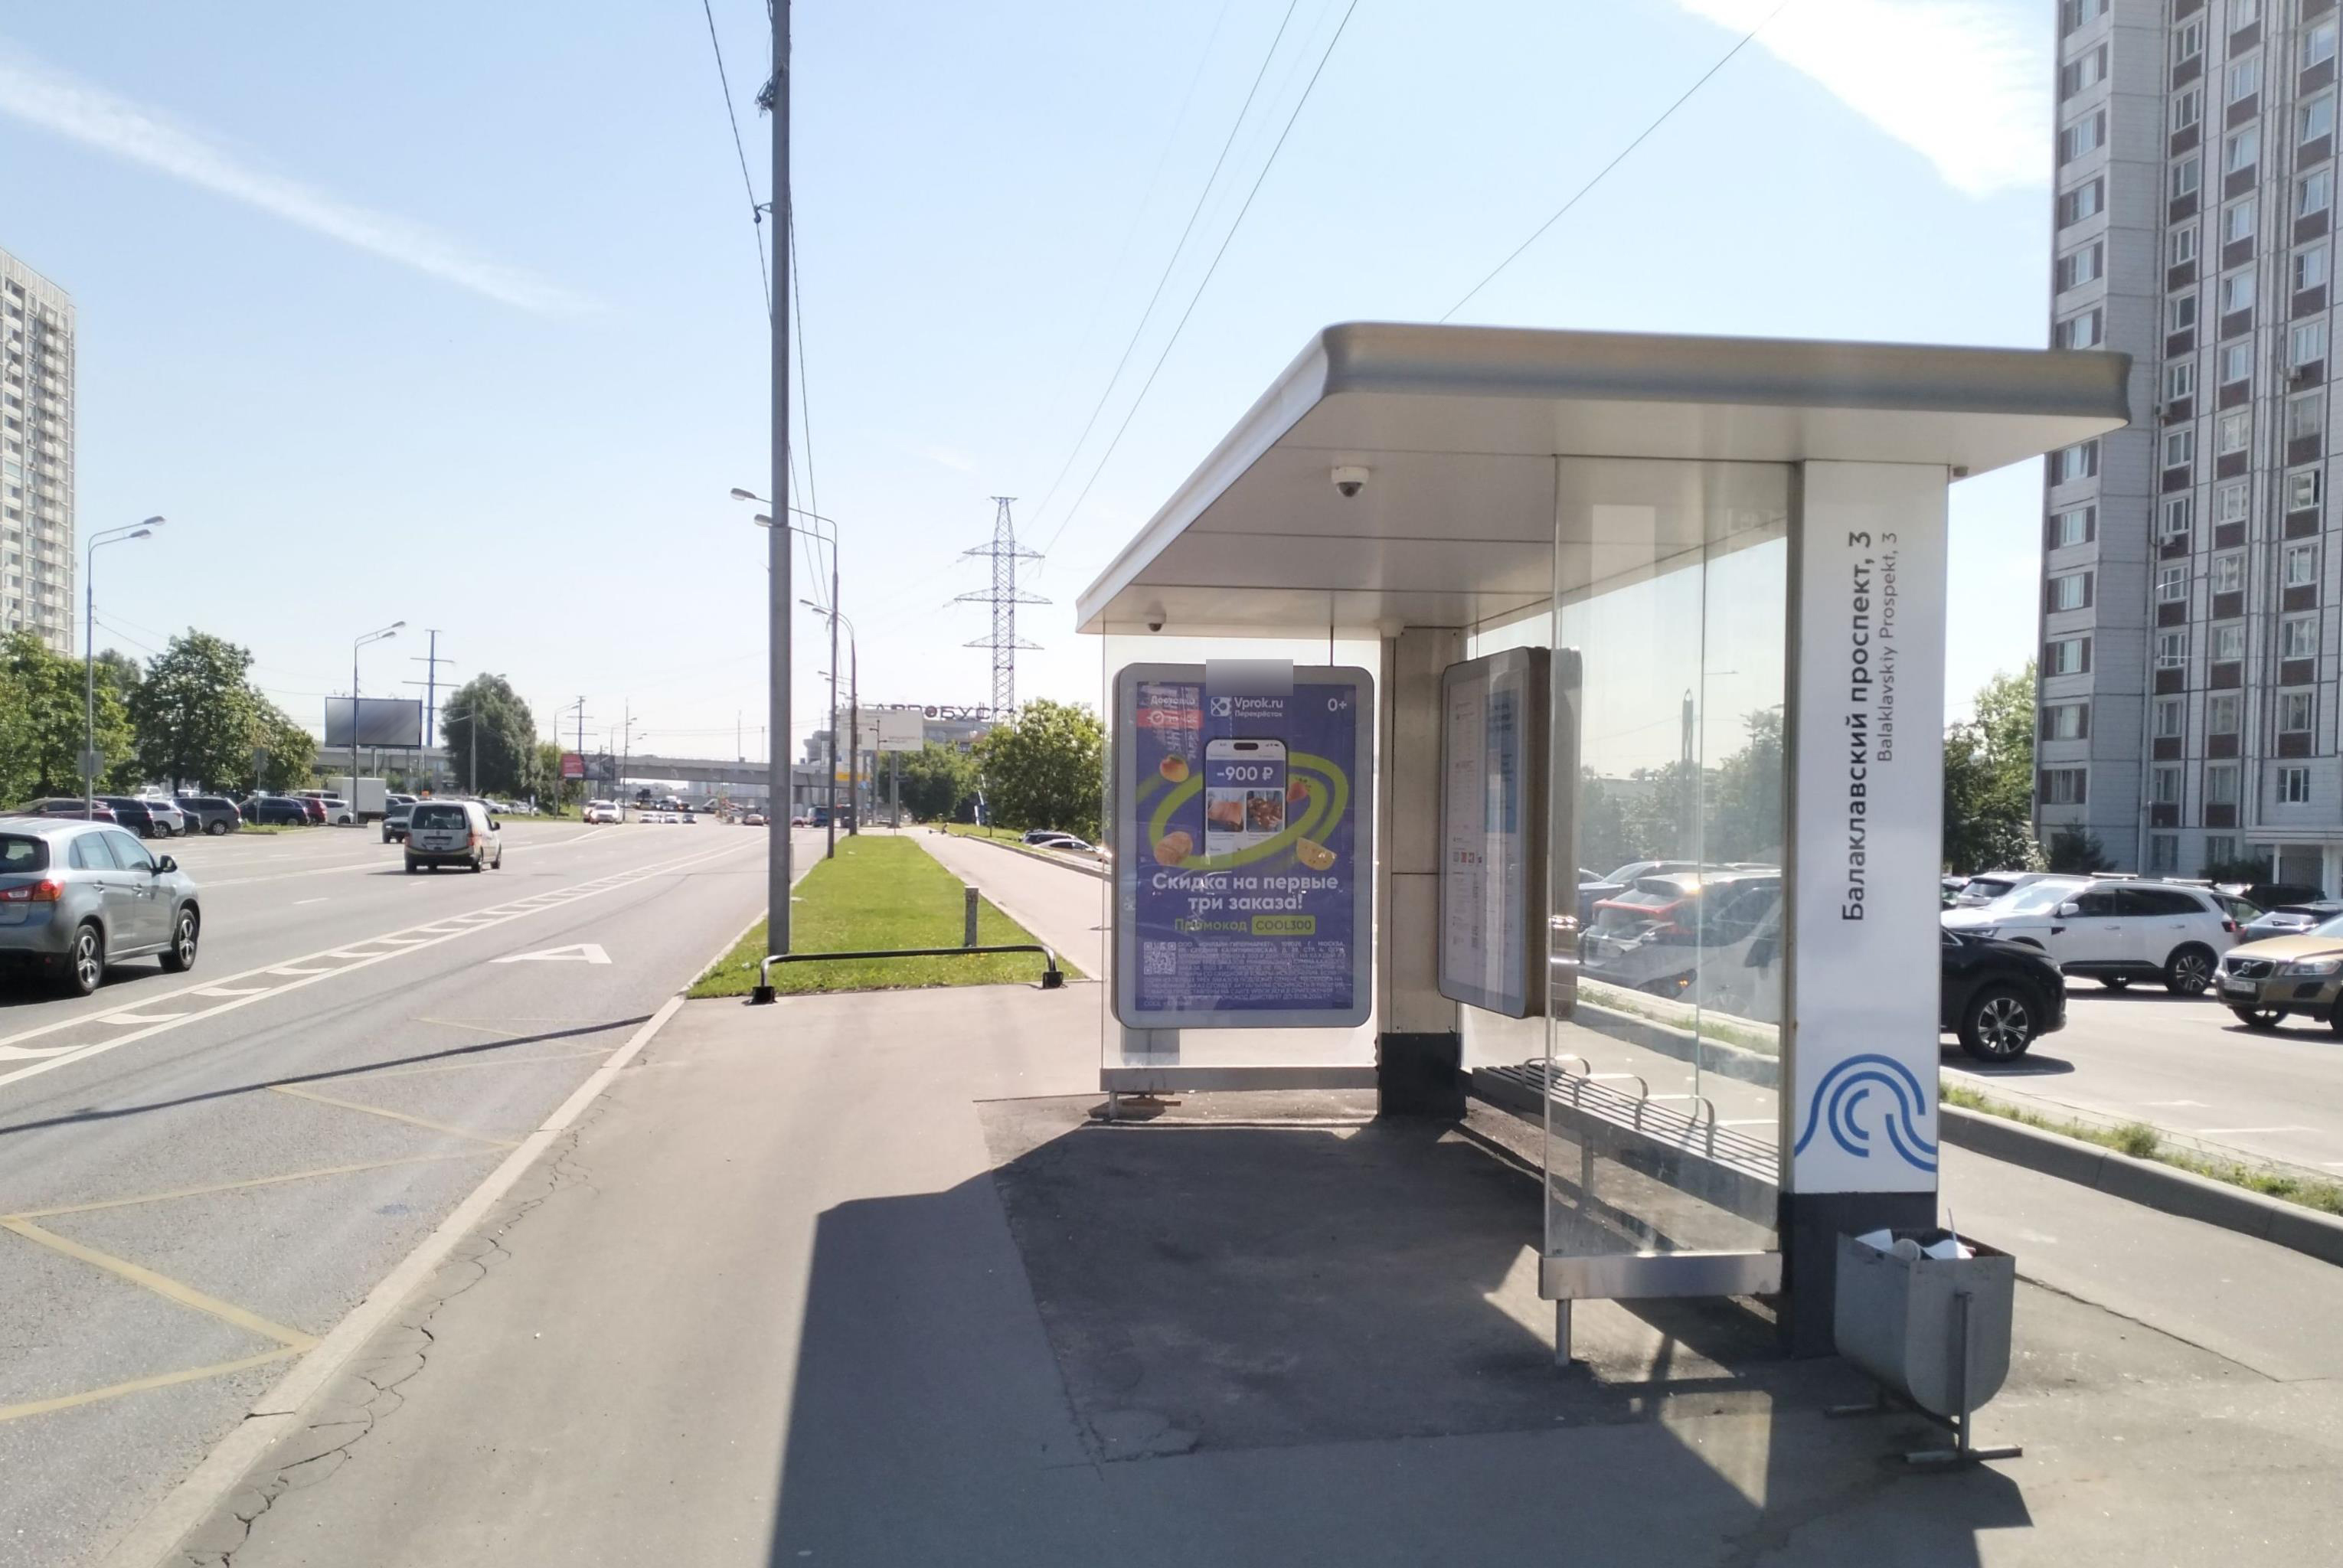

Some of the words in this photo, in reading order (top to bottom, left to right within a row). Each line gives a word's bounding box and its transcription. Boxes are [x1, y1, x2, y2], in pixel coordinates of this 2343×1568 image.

[1848, 531, 1871, 548] 3
[1881, 532, 1897, 544] 3
[1879, 550, 1898, 638] Prospekt,
[1851, 559, 1874, 702] проспект,
[1234, 697, 1283, 710] Vprok.ru
[1328, 696, 1347, 711] 0+
[1877, 646, 1898, 761] Balaklavskiy
[1842, 714, 1868, 920] Балаклавский
[1152, 874, 1227, 892] Скидка
[1233, 876, 1256, 890] на
[1263, 876, 1338, 893] первые
[1188, 897, 1224, 912] три
[1229, 893, 1302, 910] заказа!
[1175, 918, 1247, 932] Промокод
[1255, 920, 1312, 930] COOL300
